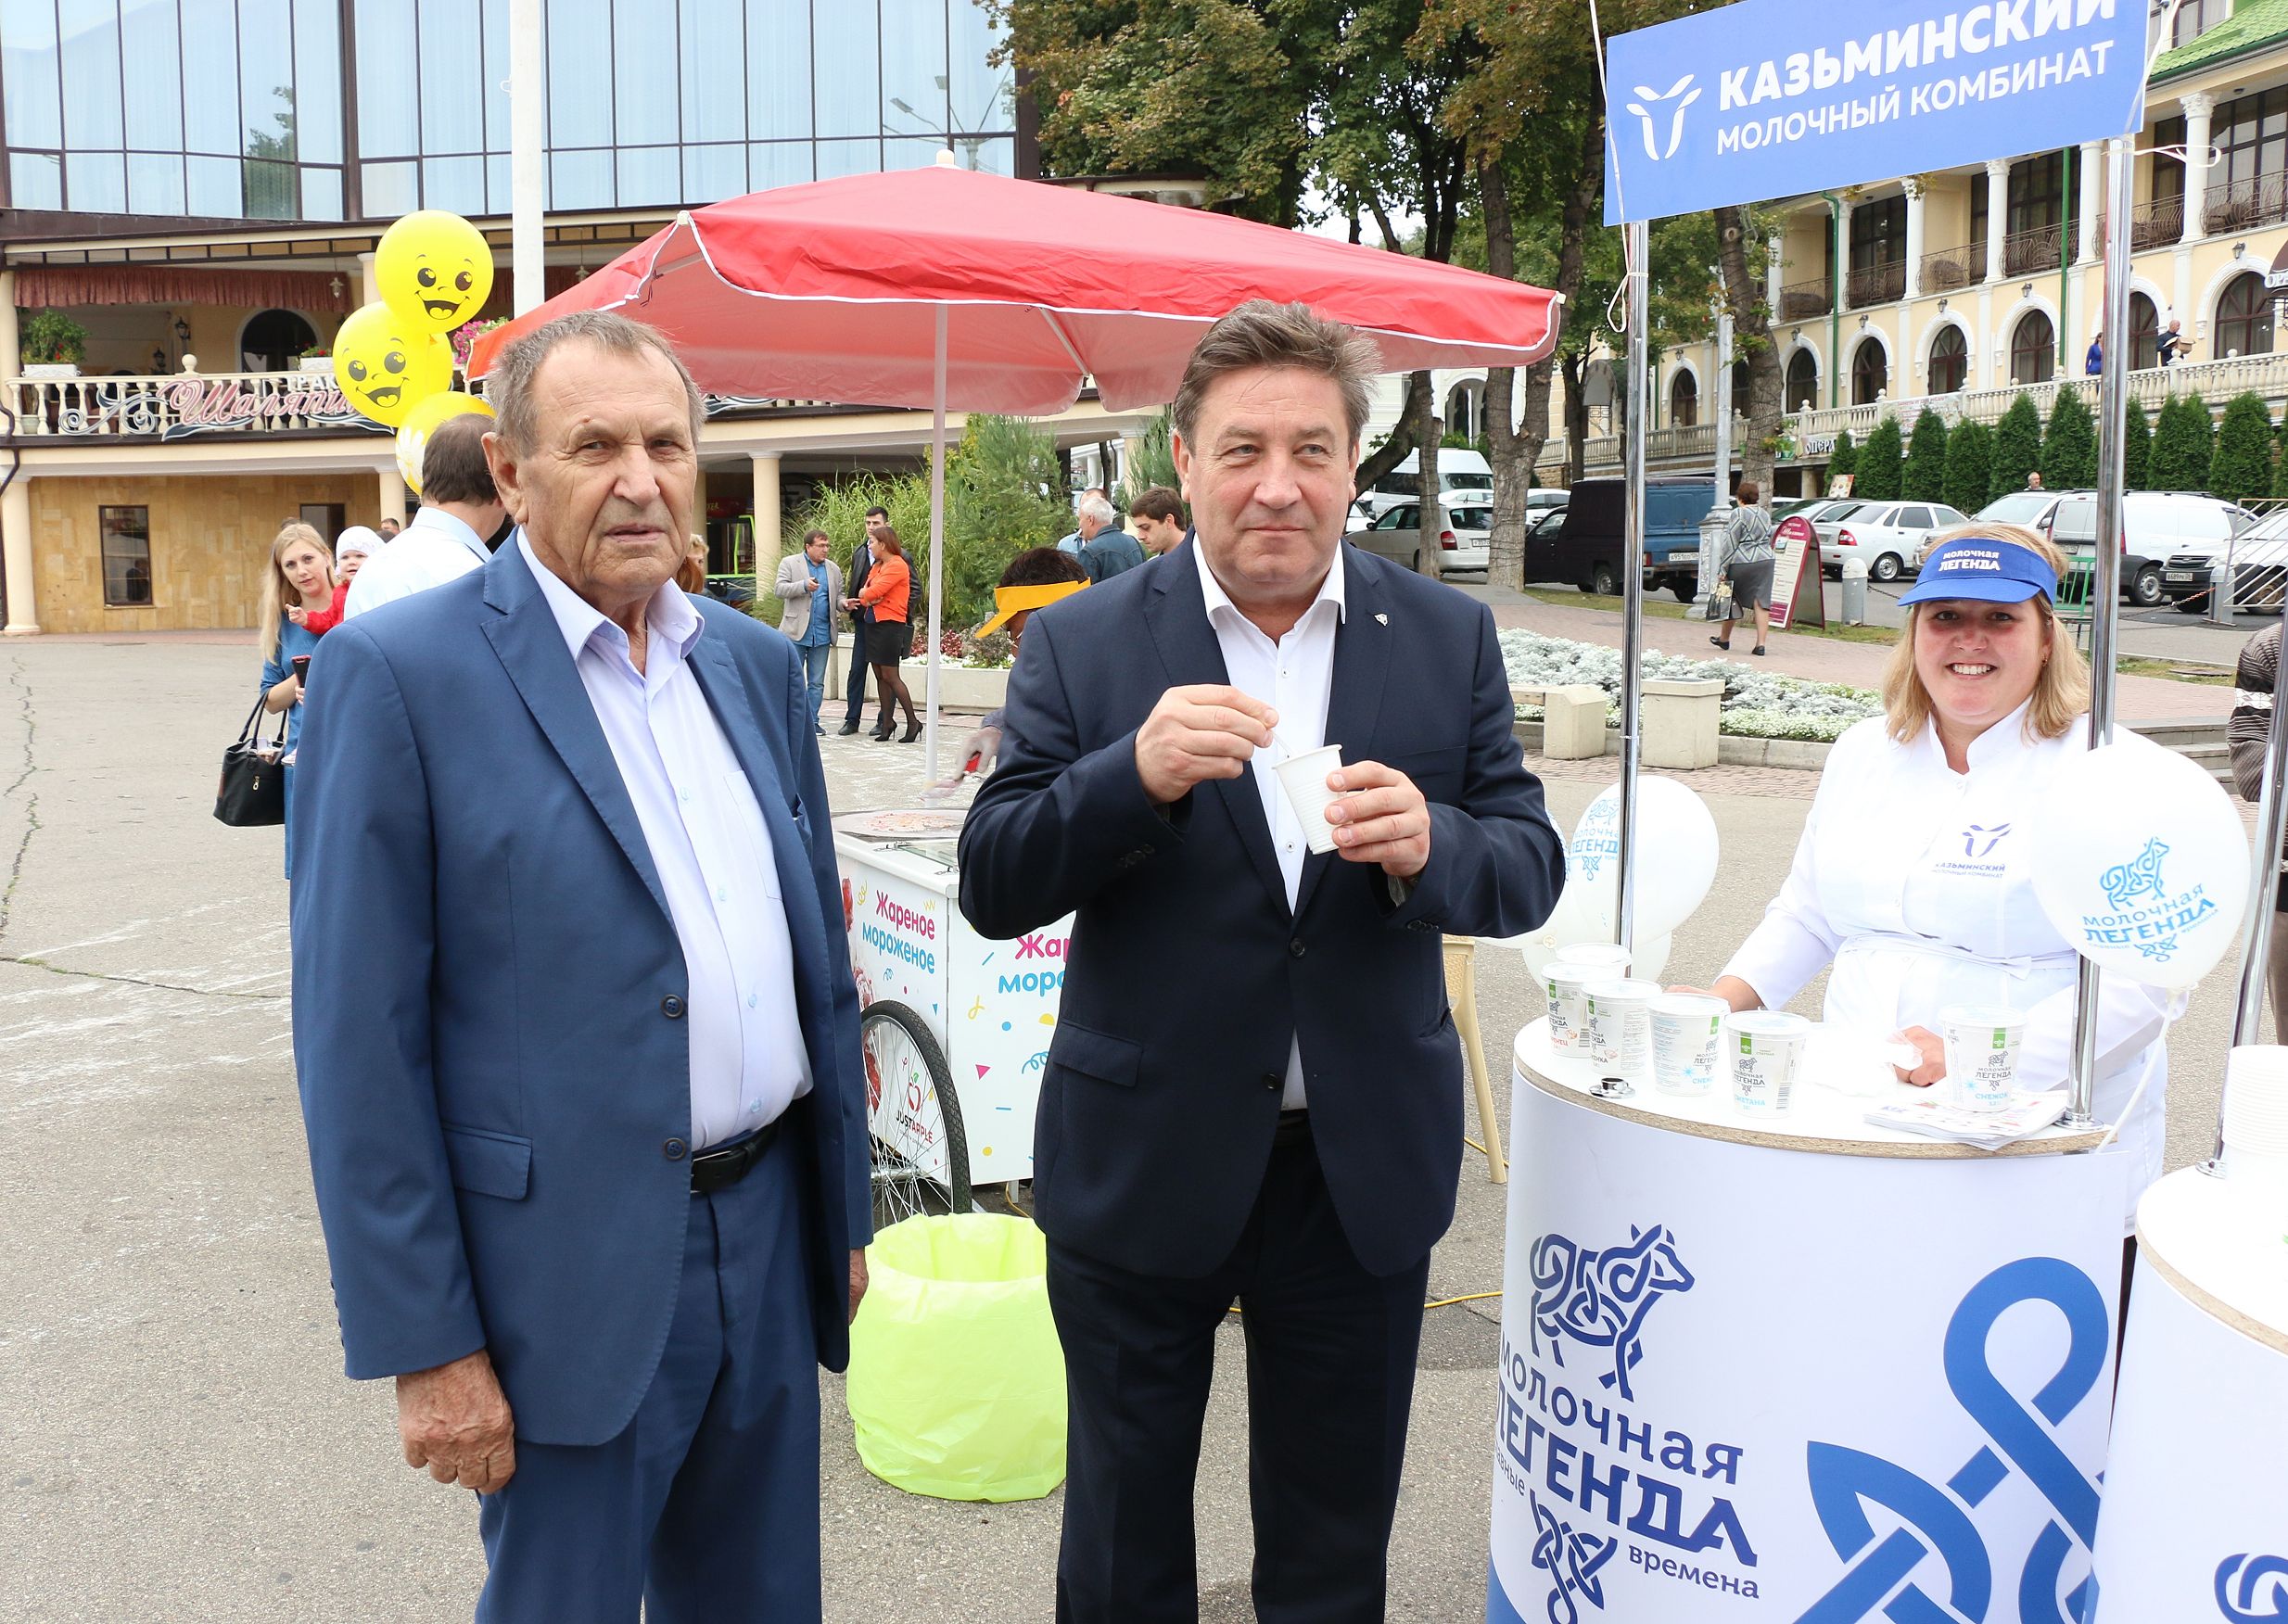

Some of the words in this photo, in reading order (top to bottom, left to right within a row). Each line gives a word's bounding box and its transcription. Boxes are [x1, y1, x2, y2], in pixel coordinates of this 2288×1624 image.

[1717, 88, 1900, 156] МОЛОЧНЫЙ
[1910, 40, 2114, 116] КОМБИНАТ
[156, 378, 360, 425] Шаляпи
[1938, 558, 2001, 571] ЛЕГЕНДА
[1572, 839, 1618, 854] ЕГЕНД
[876, 890, 934, 940] Жареное
[2083, 898, 2215, 944] ЛЕГЕНДА
[863, 921, 934, 974] мороженое
[1497, 1375, 1759, 1567] ЛЕГЕНДА
[1629, 1544, 1760, 1599] времена
